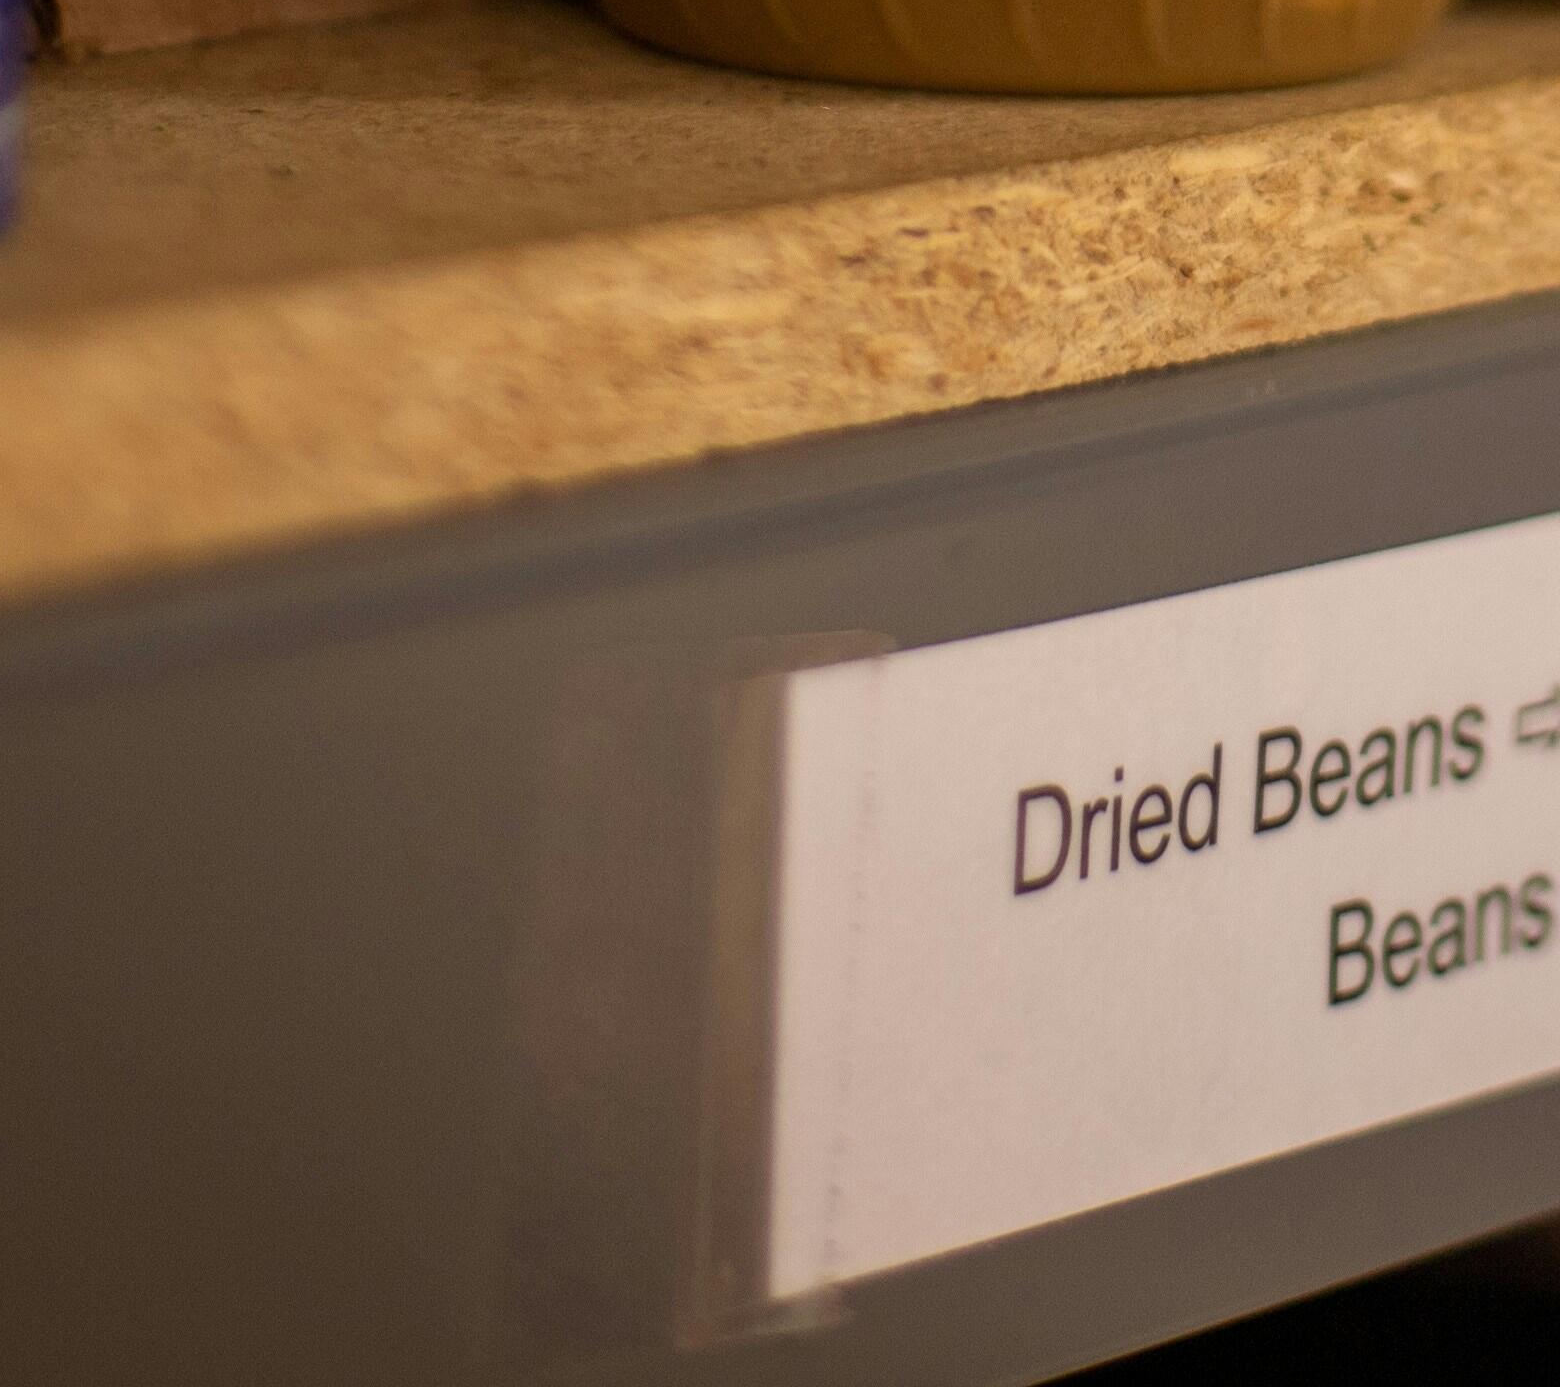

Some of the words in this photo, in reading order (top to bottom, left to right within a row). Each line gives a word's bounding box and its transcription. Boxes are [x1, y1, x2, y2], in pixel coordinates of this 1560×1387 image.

[1013, 740, 1224, 897] Dried
[1253, 703, 1487, 836] Beans
[1326, 871, 1556, 1007] Beans
